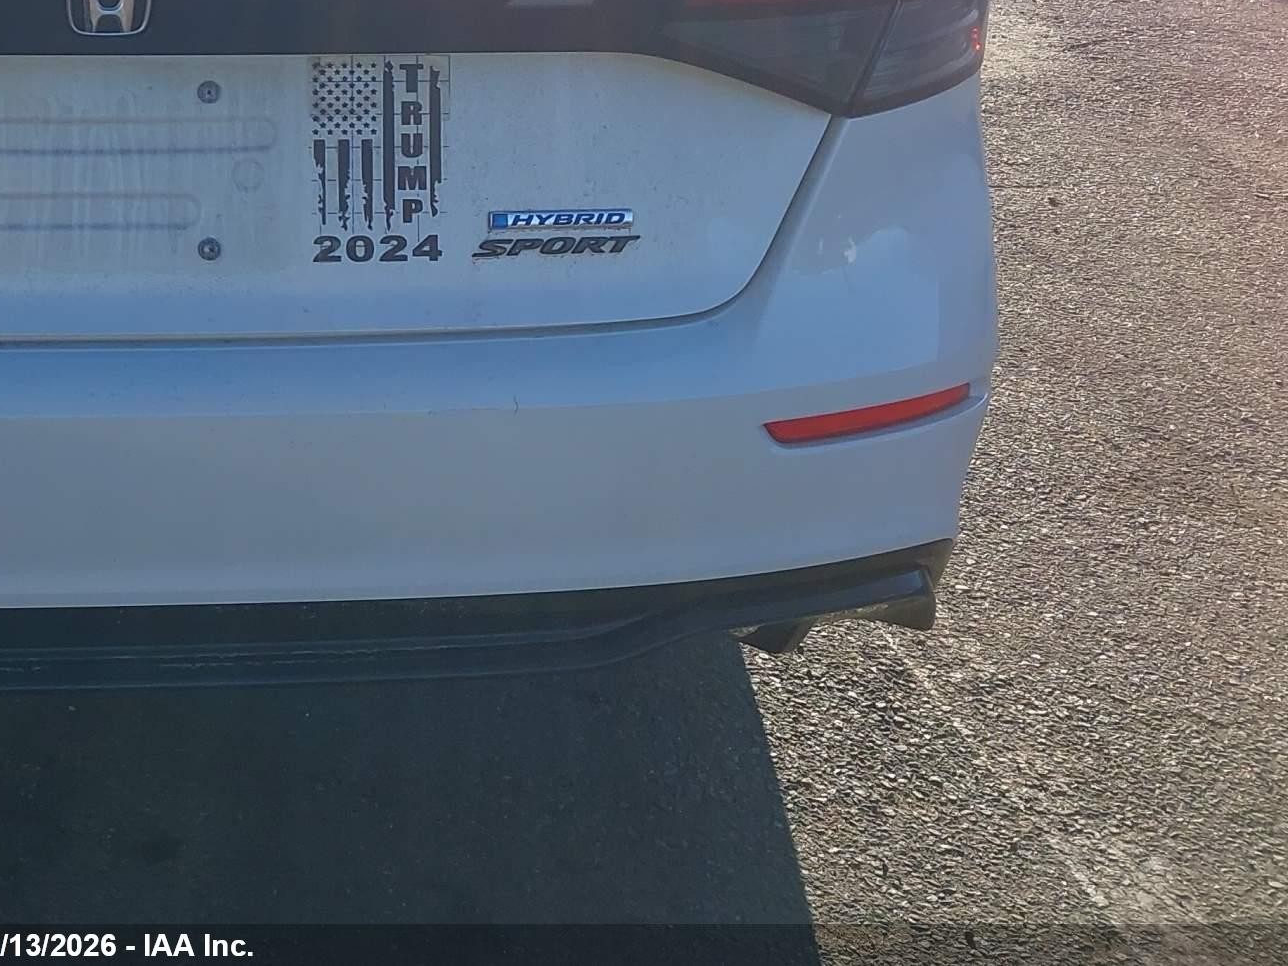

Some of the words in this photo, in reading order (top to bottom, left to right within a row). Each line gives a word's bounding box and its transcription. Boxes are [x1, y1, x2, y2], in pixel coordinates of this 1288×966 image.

[397, 63, 428, 224] TRUMP
[512, 212, 626, 227] HYBRID
[312, 235, 443, 263] 2024
[471, 235, 641, 258] SPORT
